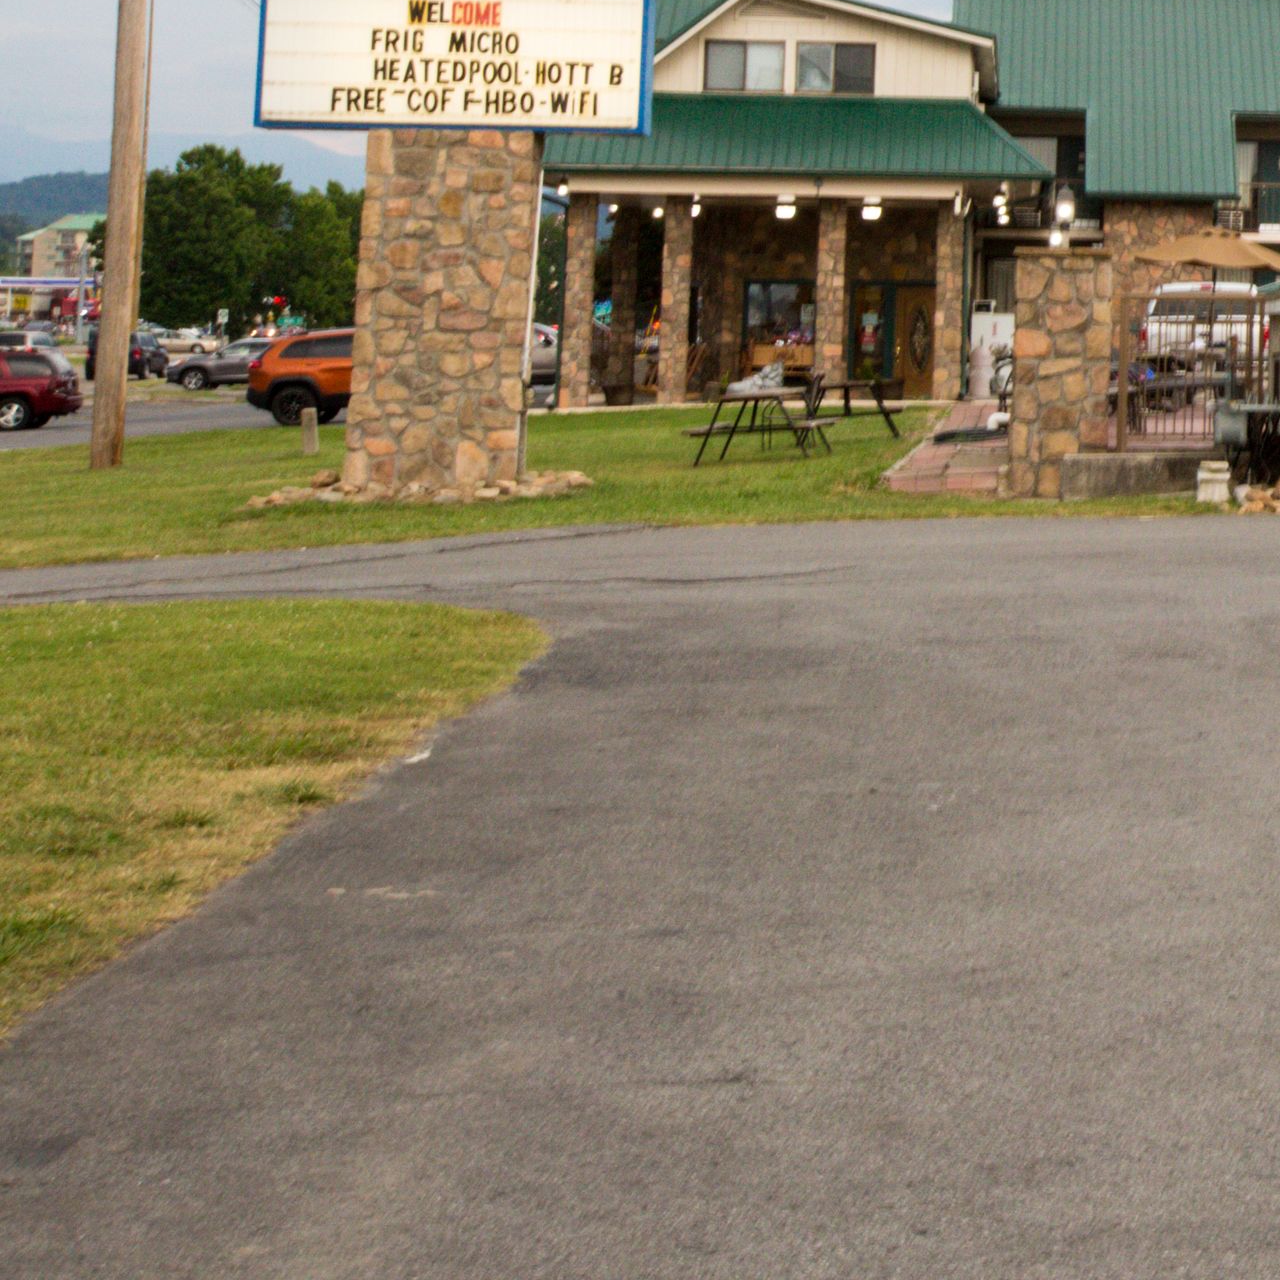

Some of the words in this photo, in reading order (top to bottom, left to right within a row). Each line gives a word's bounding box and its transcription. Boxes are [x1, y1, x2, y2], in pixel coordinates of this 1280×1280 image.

[371, 28, 425, 53] FRIG
[449, 32, 520, 55] MICRO
[609, 63, 624, 86] B
